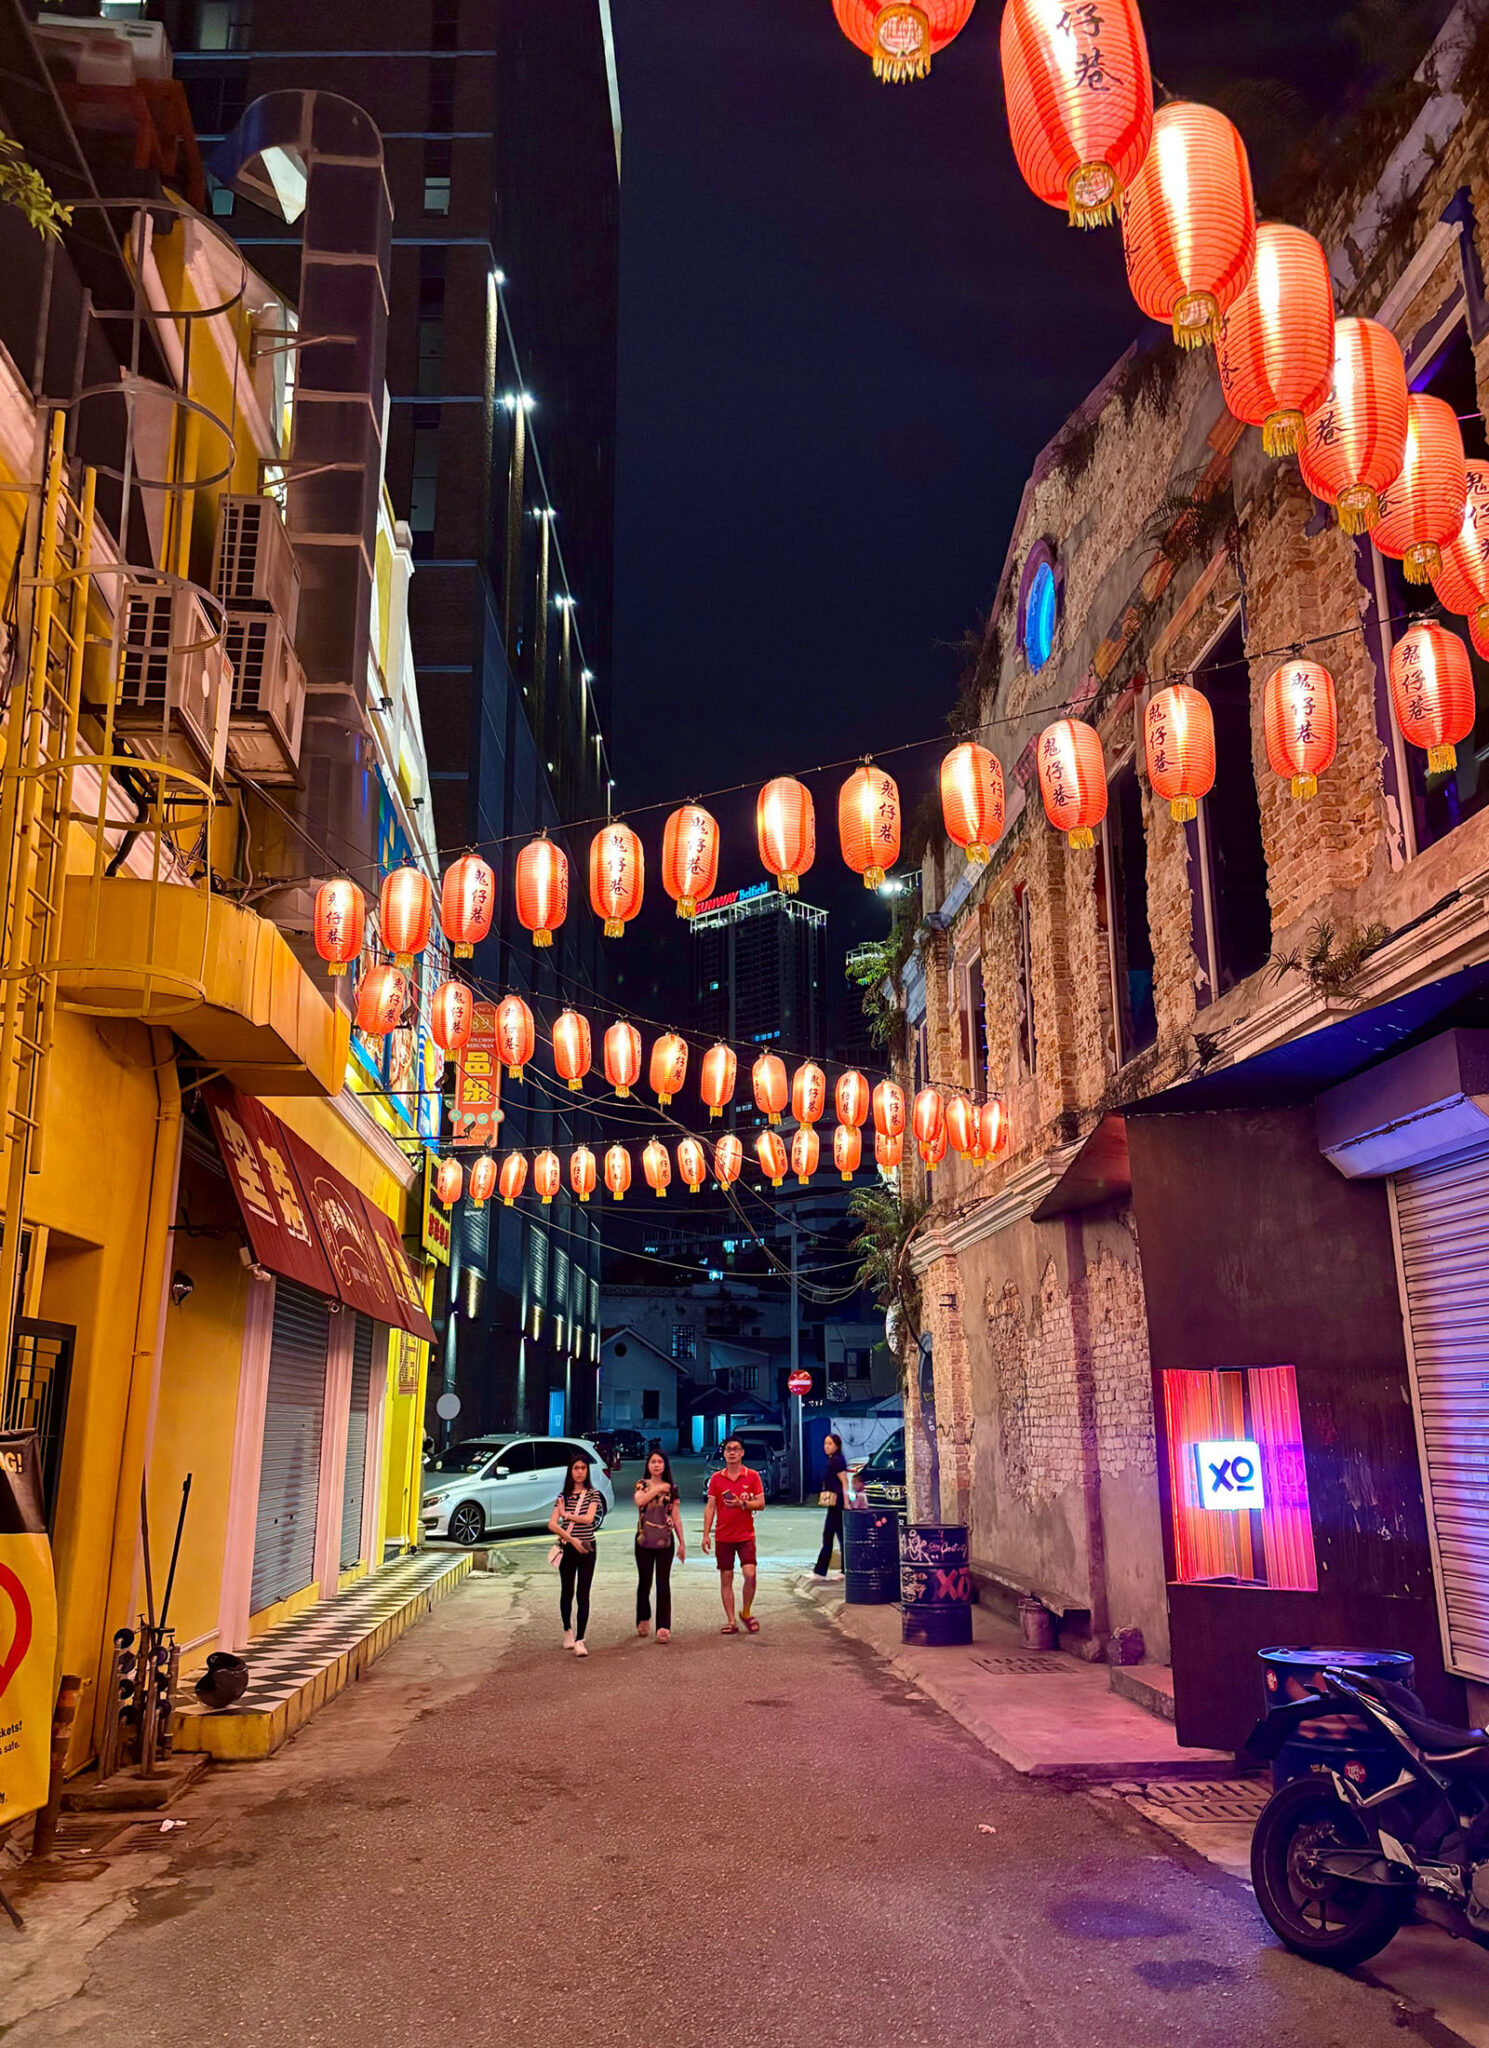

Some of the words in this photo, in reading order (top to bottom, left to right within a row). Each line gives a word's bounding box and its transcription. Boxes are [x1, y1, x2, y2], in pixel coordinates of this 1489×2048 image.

[1291, 672, 1321, 744] 鬼仔巷
[1401, 644, 1434, 721] 鬼仔巷
[1149, 703, 1175, 775] 鬼仔巷
[1042, 737, 1076, 808] 鬼仔巷
[879, 779, 897, 845] 鬼仔巷
[470, 868, 489, 925] 鬼仔巷
[607, 834, 630, 897] 鬼仔巷
[695, 891, 739, 914] SUNWAY
[738, 881, 768, 900] Belfield
[451, 990, 465, 1034] 鬼仔巷
[1208, 1455, 1255, 1492] XO
